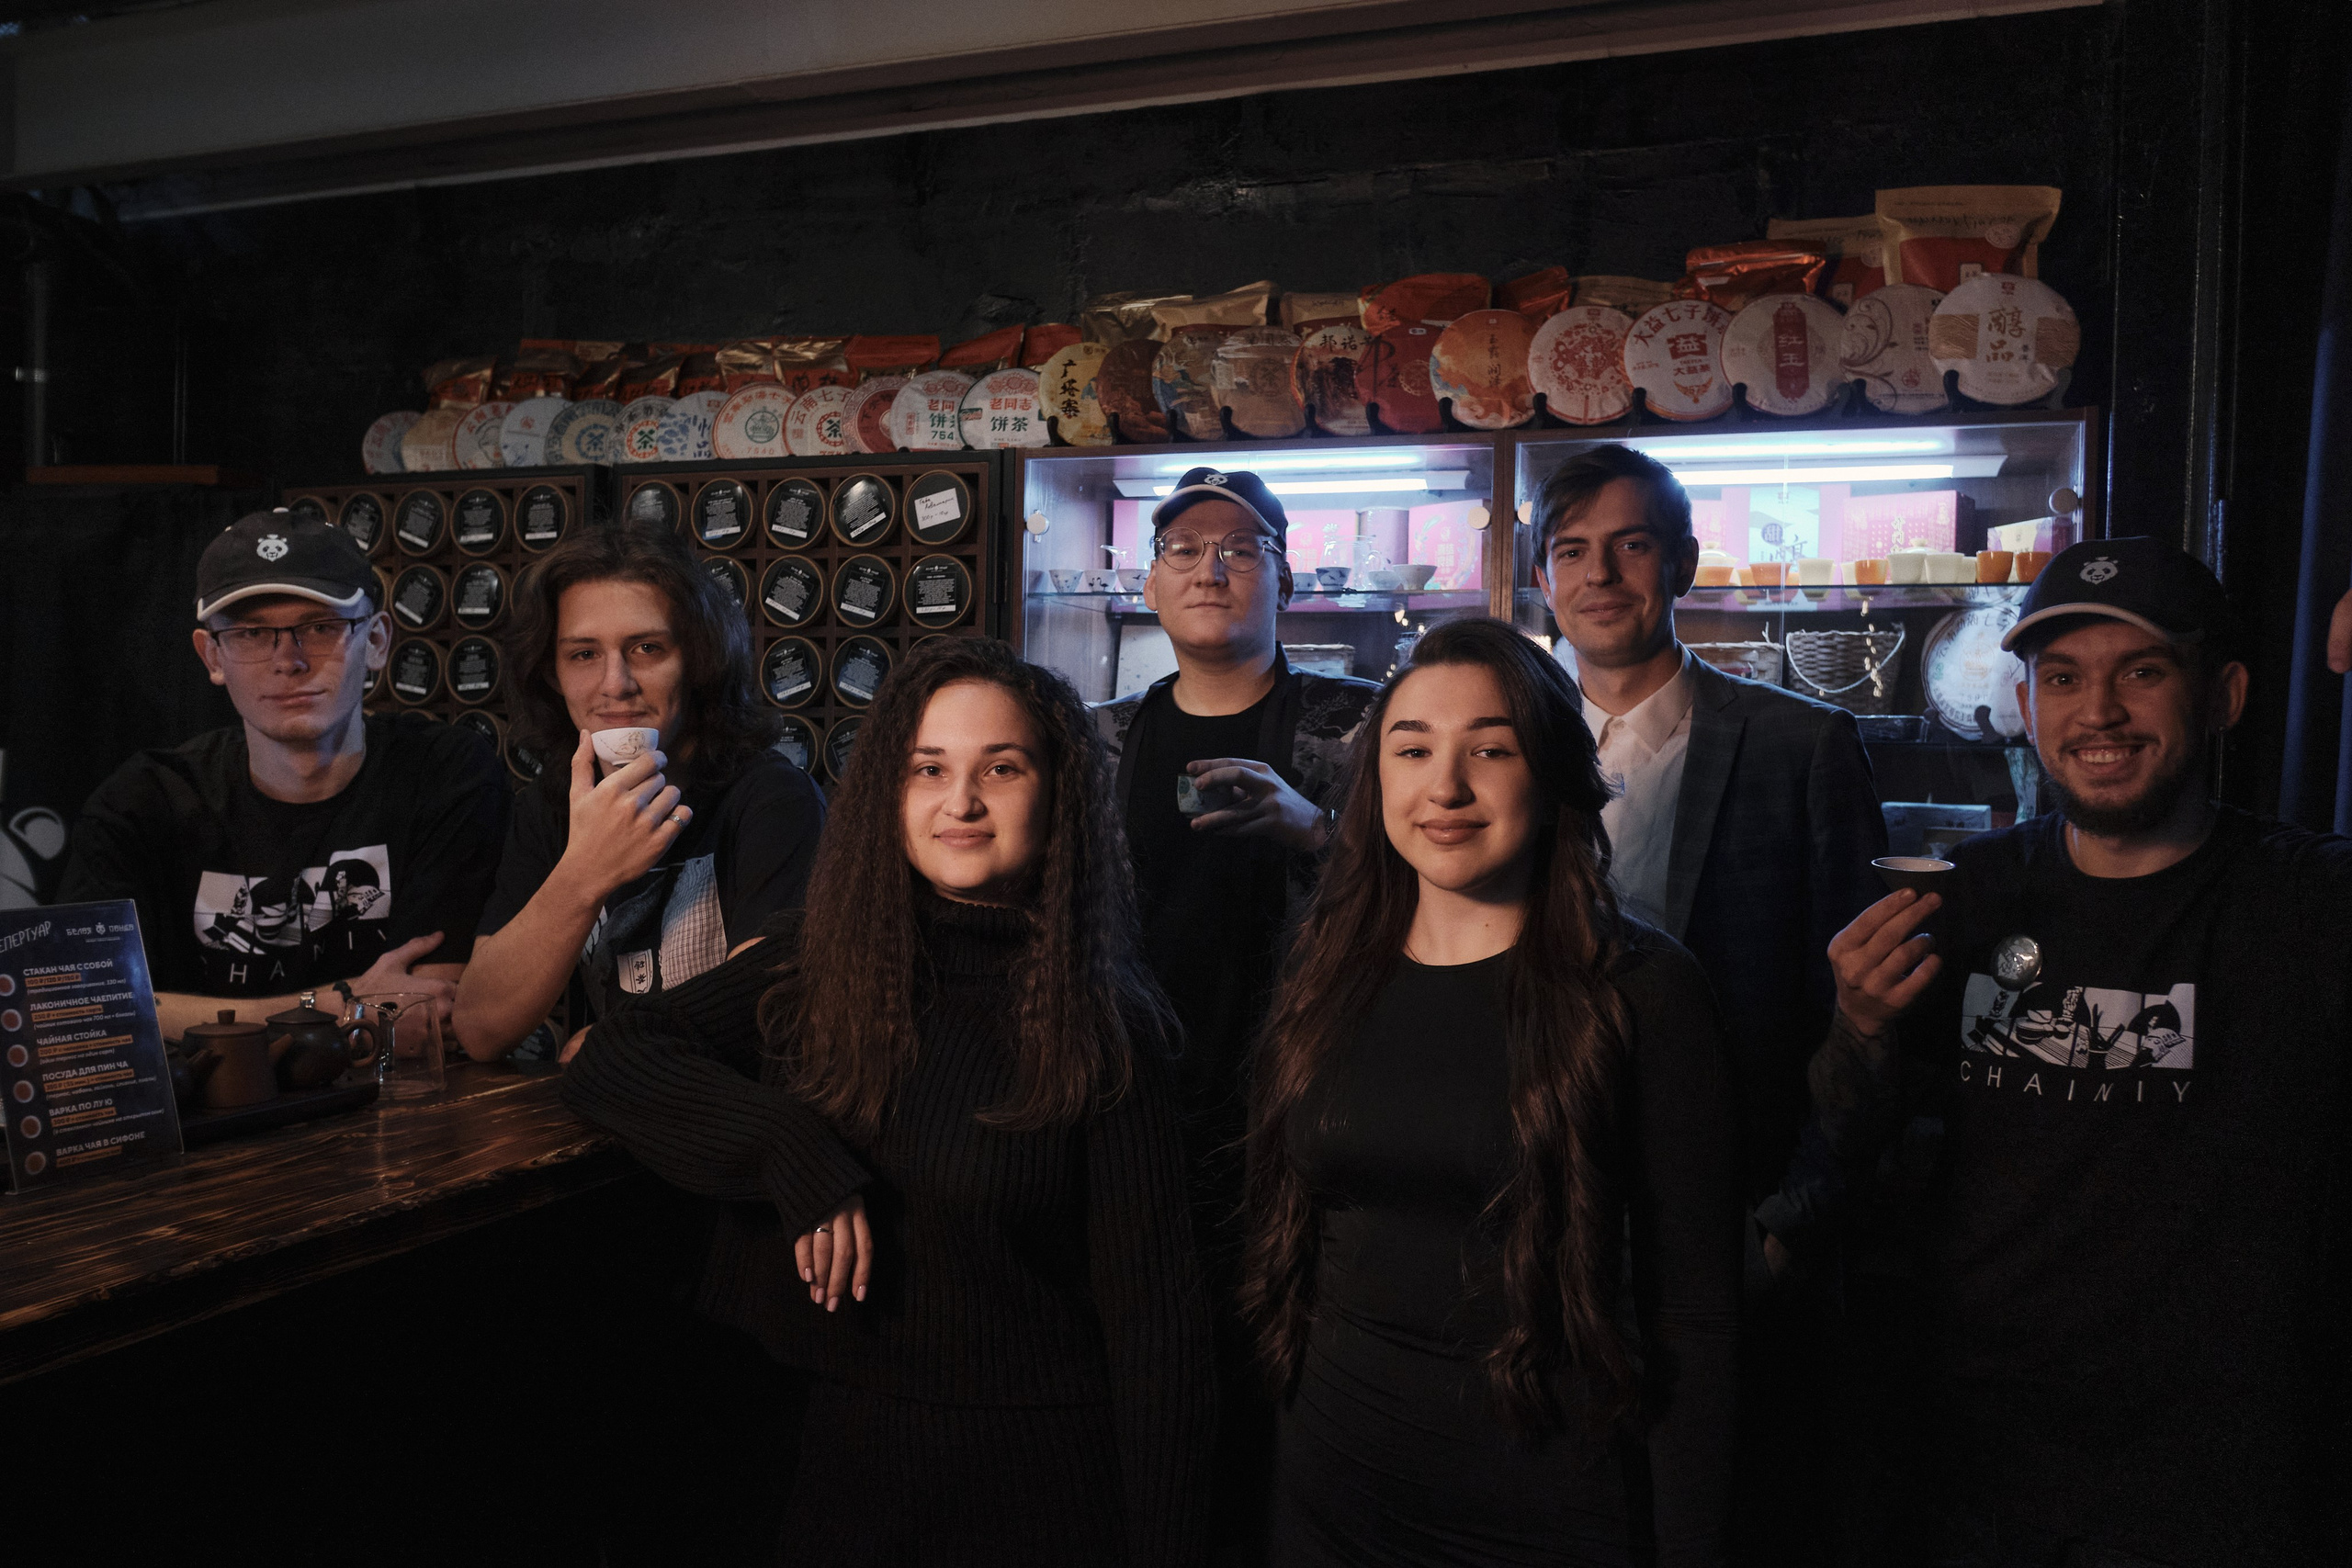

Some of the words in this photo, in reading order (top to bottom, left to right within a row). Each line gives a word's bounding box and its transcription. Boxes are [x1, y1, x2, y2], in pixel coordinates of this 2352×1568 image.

[989, 398, 1033, 411] 老同志
[990, 416, 1028, 432] 饼茶
[23, 966, 57, 976] СТАКАН
[59, 964, 75, 973] ЧАЯ
[76, 963, 83, 971] С
[84, 958, 113, 970] СОБОЙ
[29, 997, 90, 1011] ЛАКОНИЧНОЕ
[90, 991, 134, 1003] ЧАЕПИТИЕ
[37, 1034, 73, 1045] ЧАЙНАЯ
[74, 1029, 107, 1041] СТОЙКА
[42, 1070, 78, 1081] ПОСУДА
[79, 1066, 97, 1077] ДЛЯ
[97, 1064, 116, 1073] ПИН
[117, 1060, 129, 1068] ЧА
[1960, 1060, 2191, 1102] CHAINIY
[49, 1105, 78, 1117] ВАРКА
[79, 1101, 92, 1111] ПО
[93, 1100, 104, 1109] ЛУ
[56, 1145, 84, 1156] ВАРКА
[85, 1140, 102, 1150] ЧАЯ
[103, 1138, 108, 1146] В
[109, 1131, 146, 1145] СИФОНЕ
